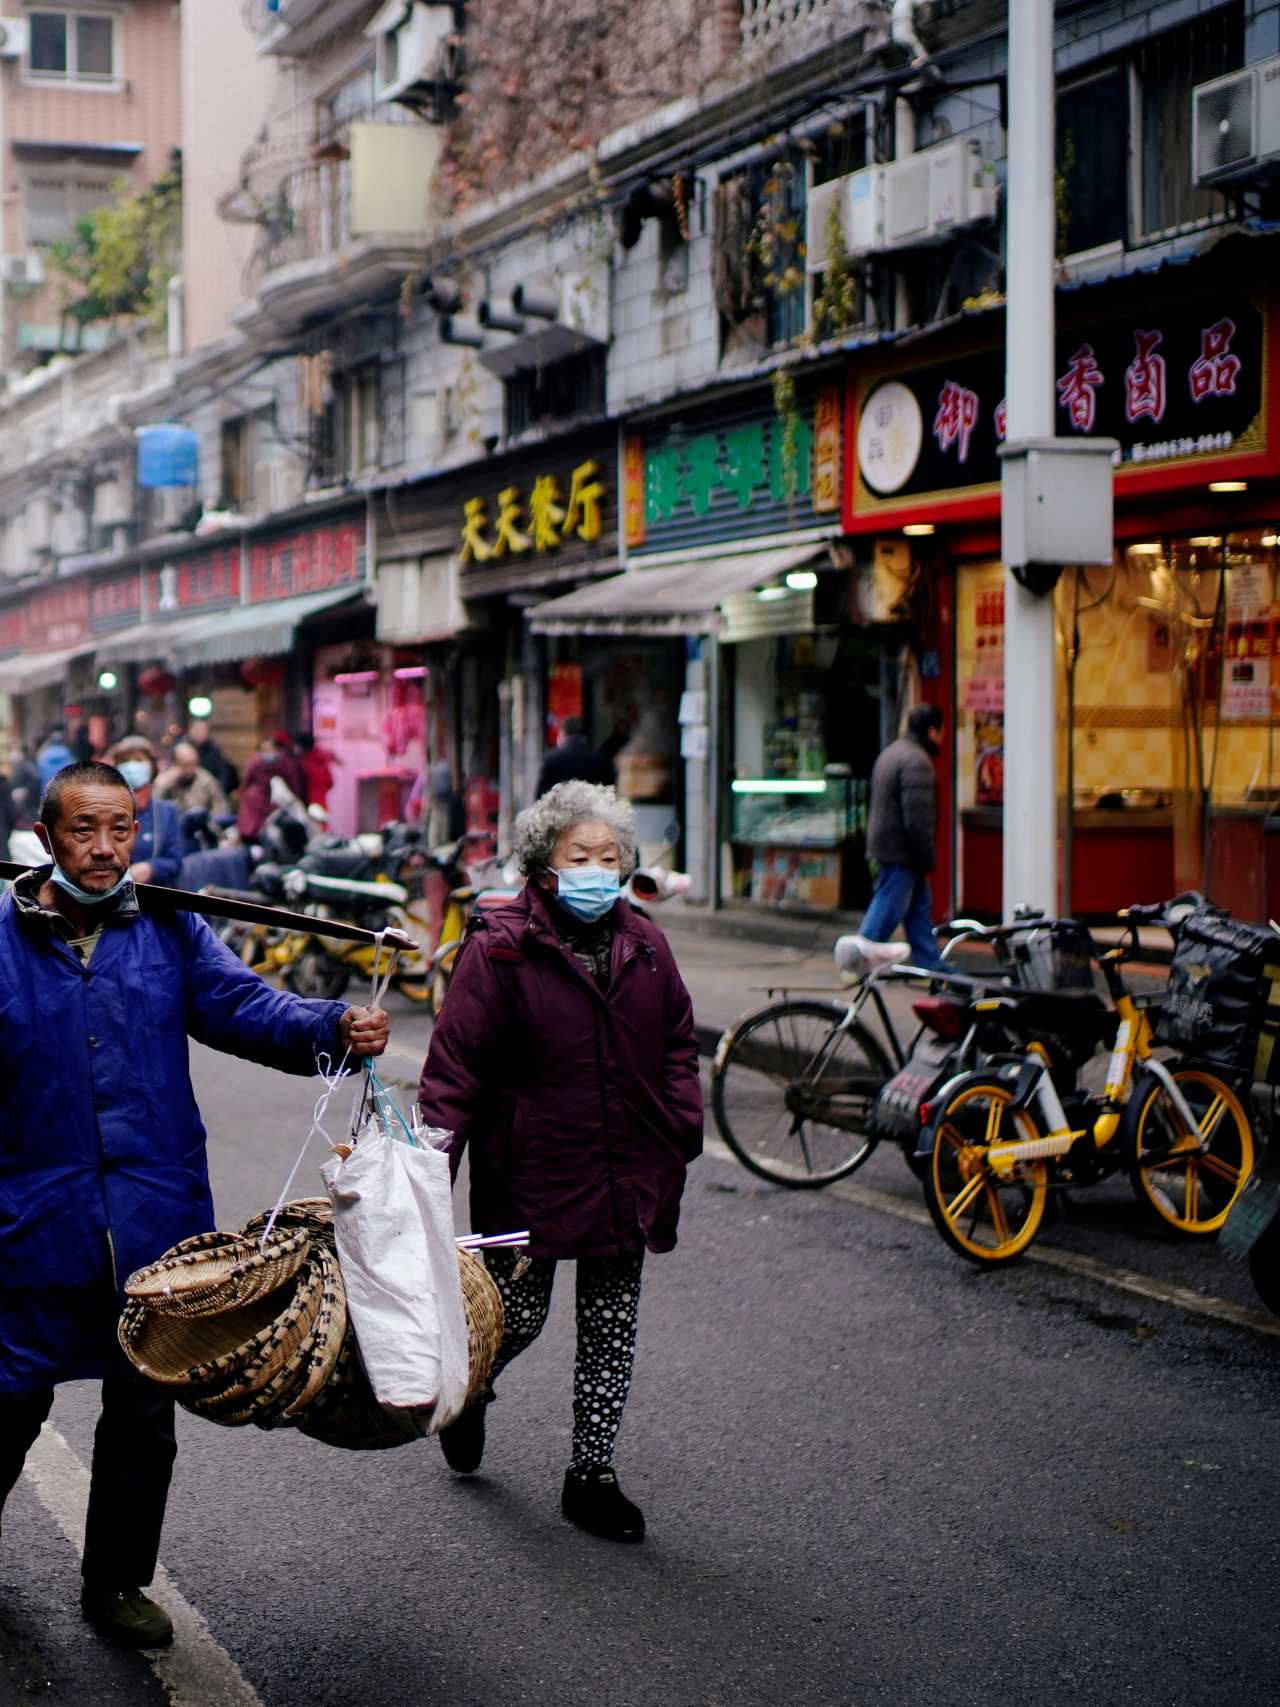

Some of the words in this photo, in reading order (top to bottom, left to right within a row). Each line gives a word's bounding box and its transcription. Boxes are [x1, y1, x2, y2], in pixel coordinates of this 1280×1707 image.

[933, 316, 1242, 464] 御香卤品
[459, 459, 603, 562] 天天餐厅
